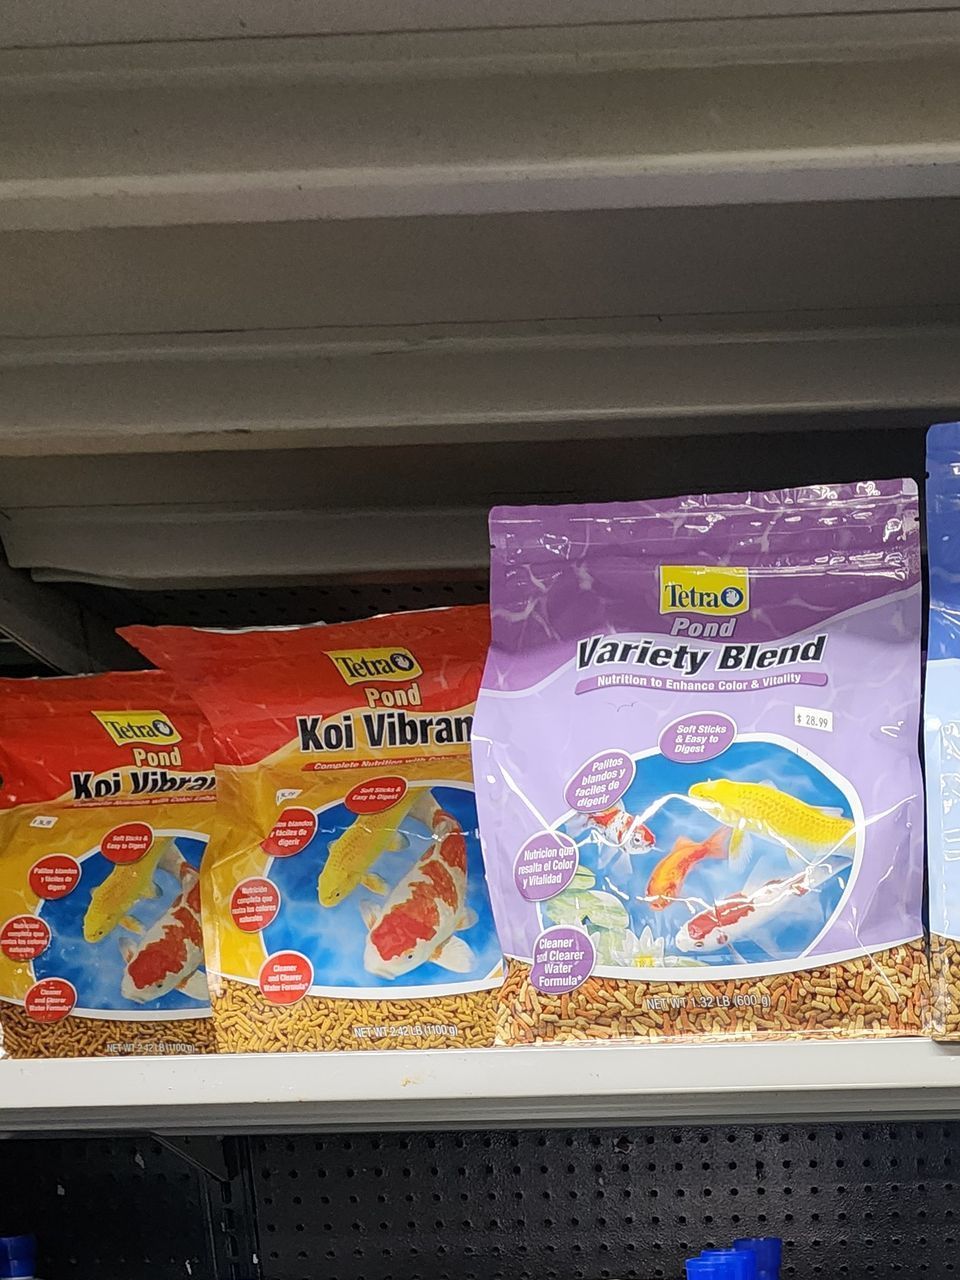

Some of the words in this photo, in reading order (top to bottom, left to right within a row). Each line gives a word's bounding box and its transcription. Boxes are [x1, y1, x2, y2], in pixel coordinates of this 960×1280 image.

[671, 618, 736, 637] Pond
[577, 637, 711, 676] Variety
[717, 634, 828, 671] Blend
[598, 675, 647, 686] Nutrition
[651, 678, 662, 688] to
[666, 680, 715, 690] Enhance
[718, 680, 748, 691] Color
[751, 680, 759, 689] &
[762, 673, 801, 687] Vitality
[365, 683, 422, 708] Pond
[677, 725, 696, 734] Soft
[698, 725, 726, 734] Sticks
[806, 715, 828, 727] 28.99
[300, 714, 354, 750] Koi
[676, 735, 683, 743] &
[685, 735, 708, 746] Easy
[710, 735, 718, 743] to
[133, 748, 182, 767] Pond
[675, 744, 704, 754] Digest
[72, 771, 122, 799] Koi
